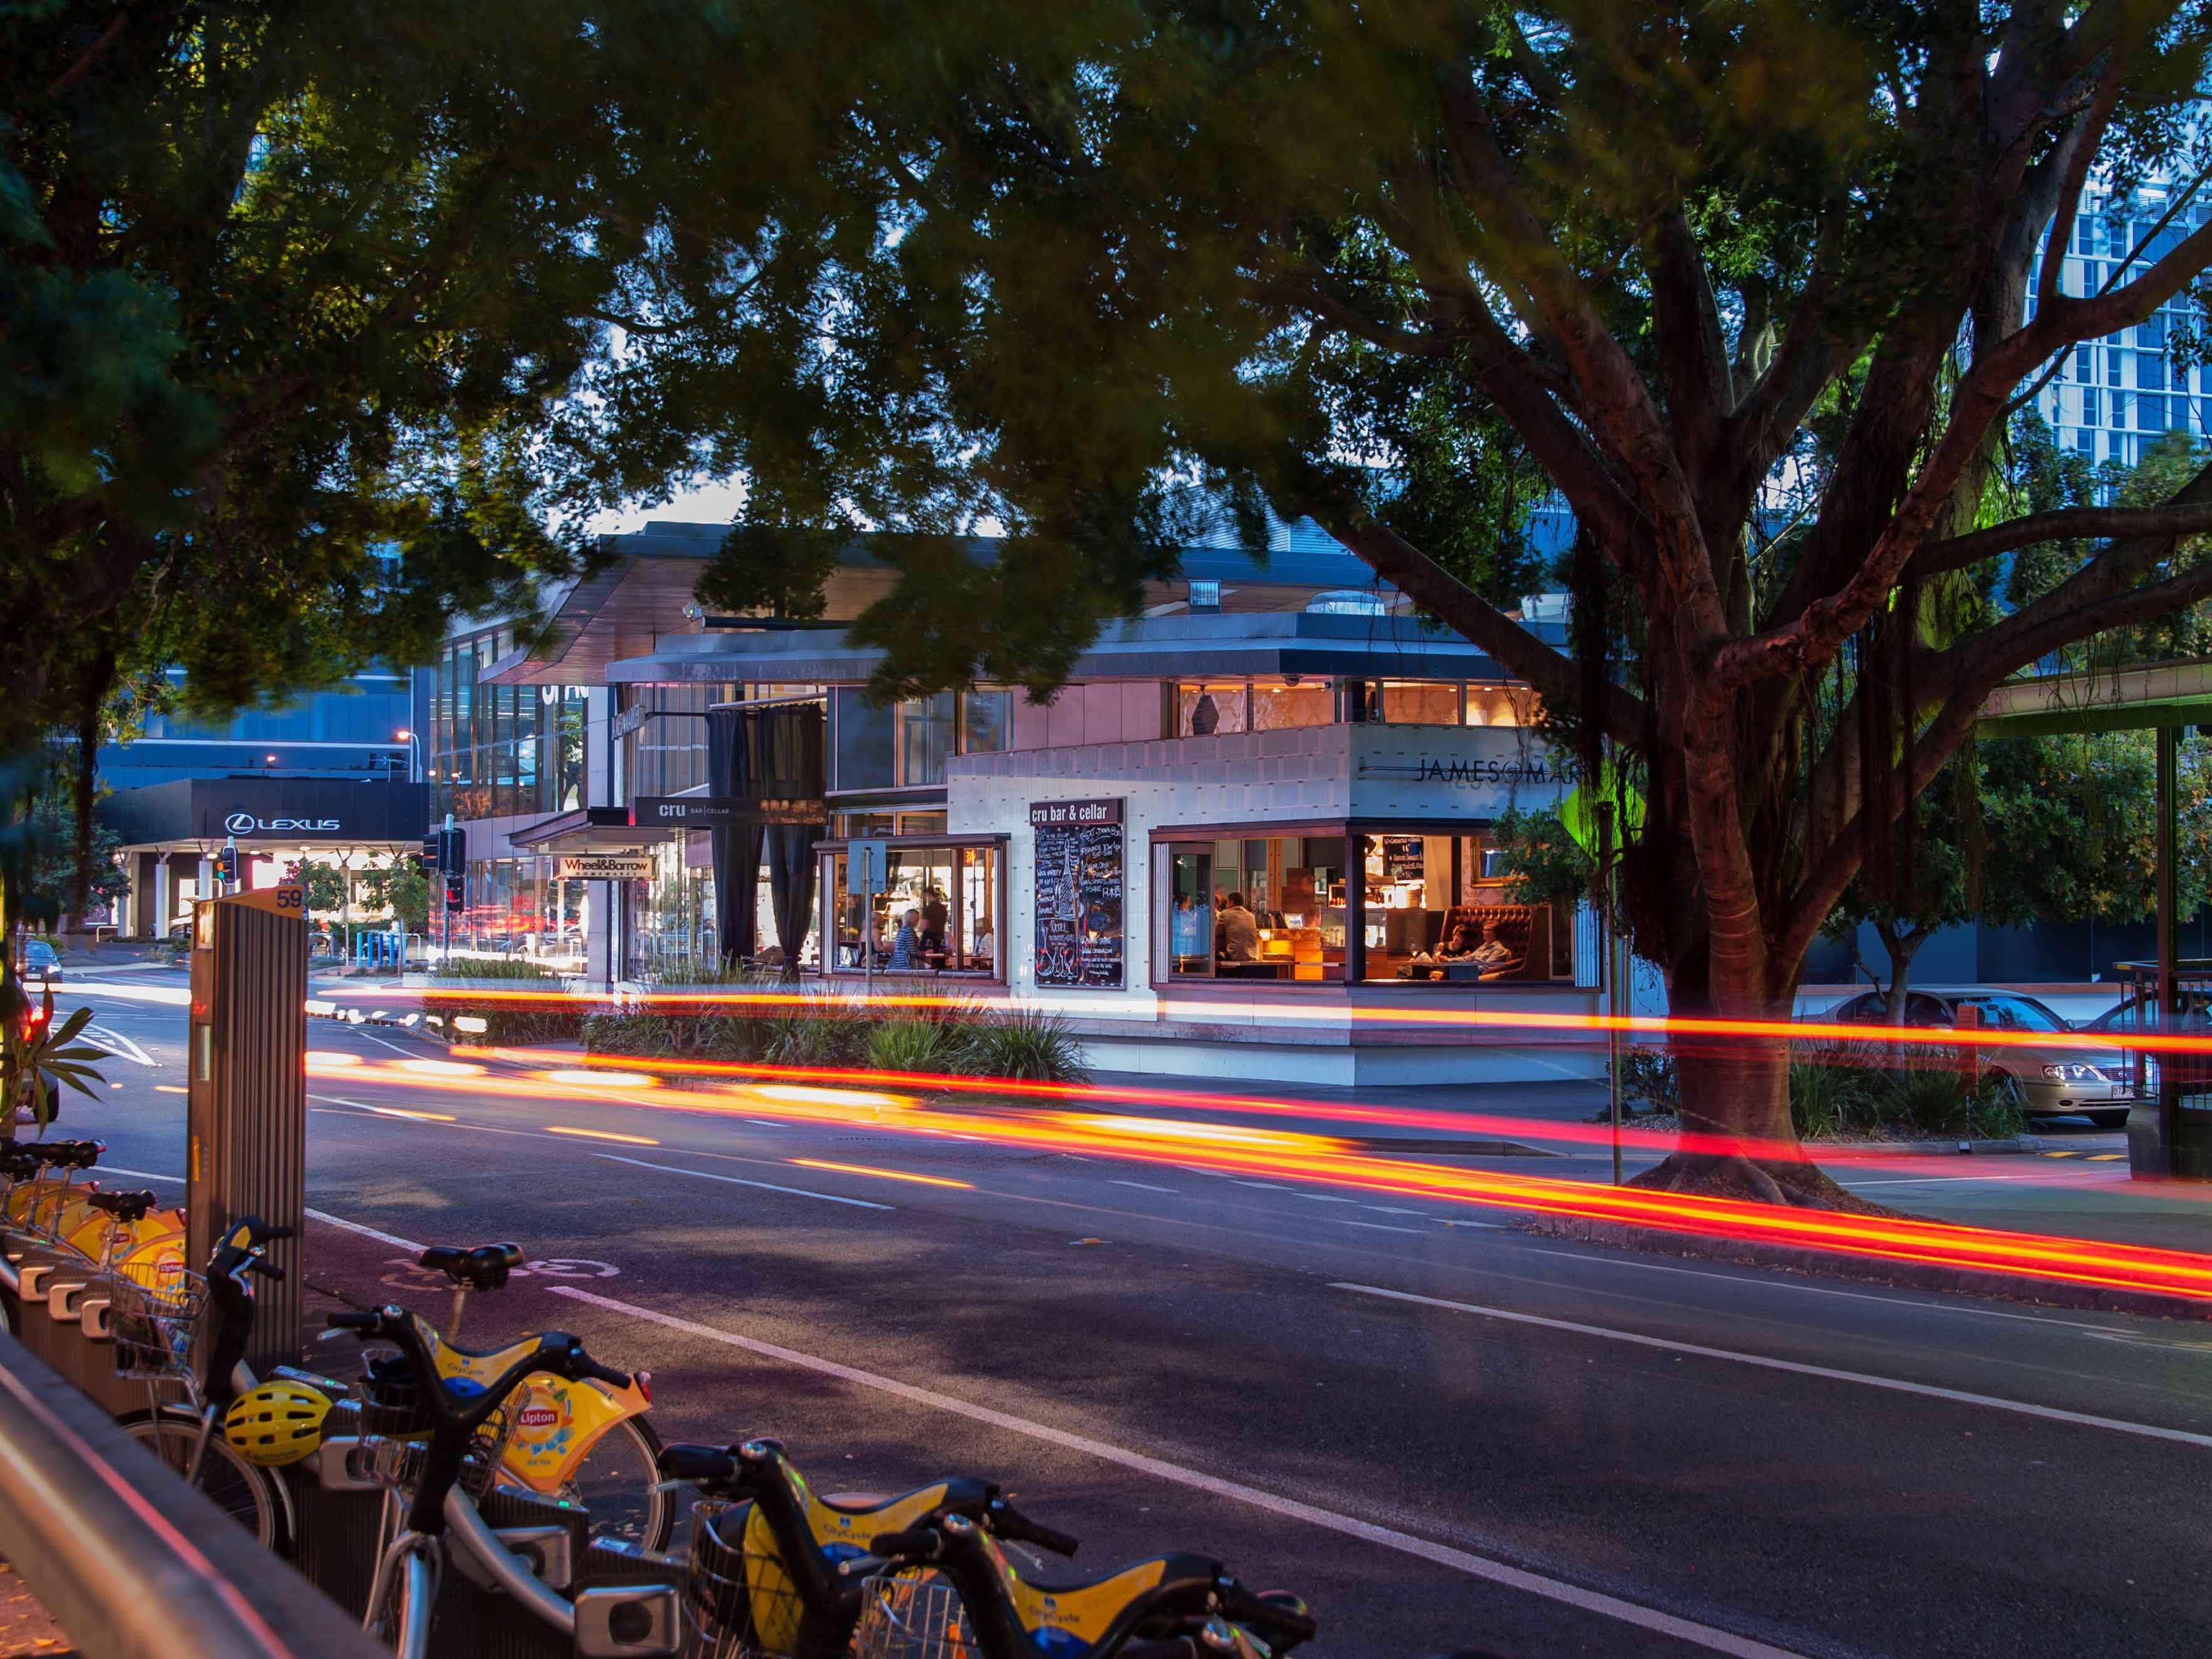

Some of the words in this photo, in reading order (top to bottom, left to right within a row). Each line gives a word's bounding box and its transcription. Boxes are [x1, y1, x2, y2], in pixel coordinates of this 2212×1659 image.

[1413, 758, 1499, 782] JAMES
[659, 804, 686, 817] cru
[1032, 810, 1047, 822] cru
[1050, 805, 1066, 823] bar
[1069, 805, 1077, 821] &
[1079, 804, 1107, 820] cellar
[258, 819, 340, 830] LEXUS
[565, 859, 648, 870] Wheel&Barrow
[276, 890, 302, 908] 59
[520, 1412, 556, 1425] Lipton
